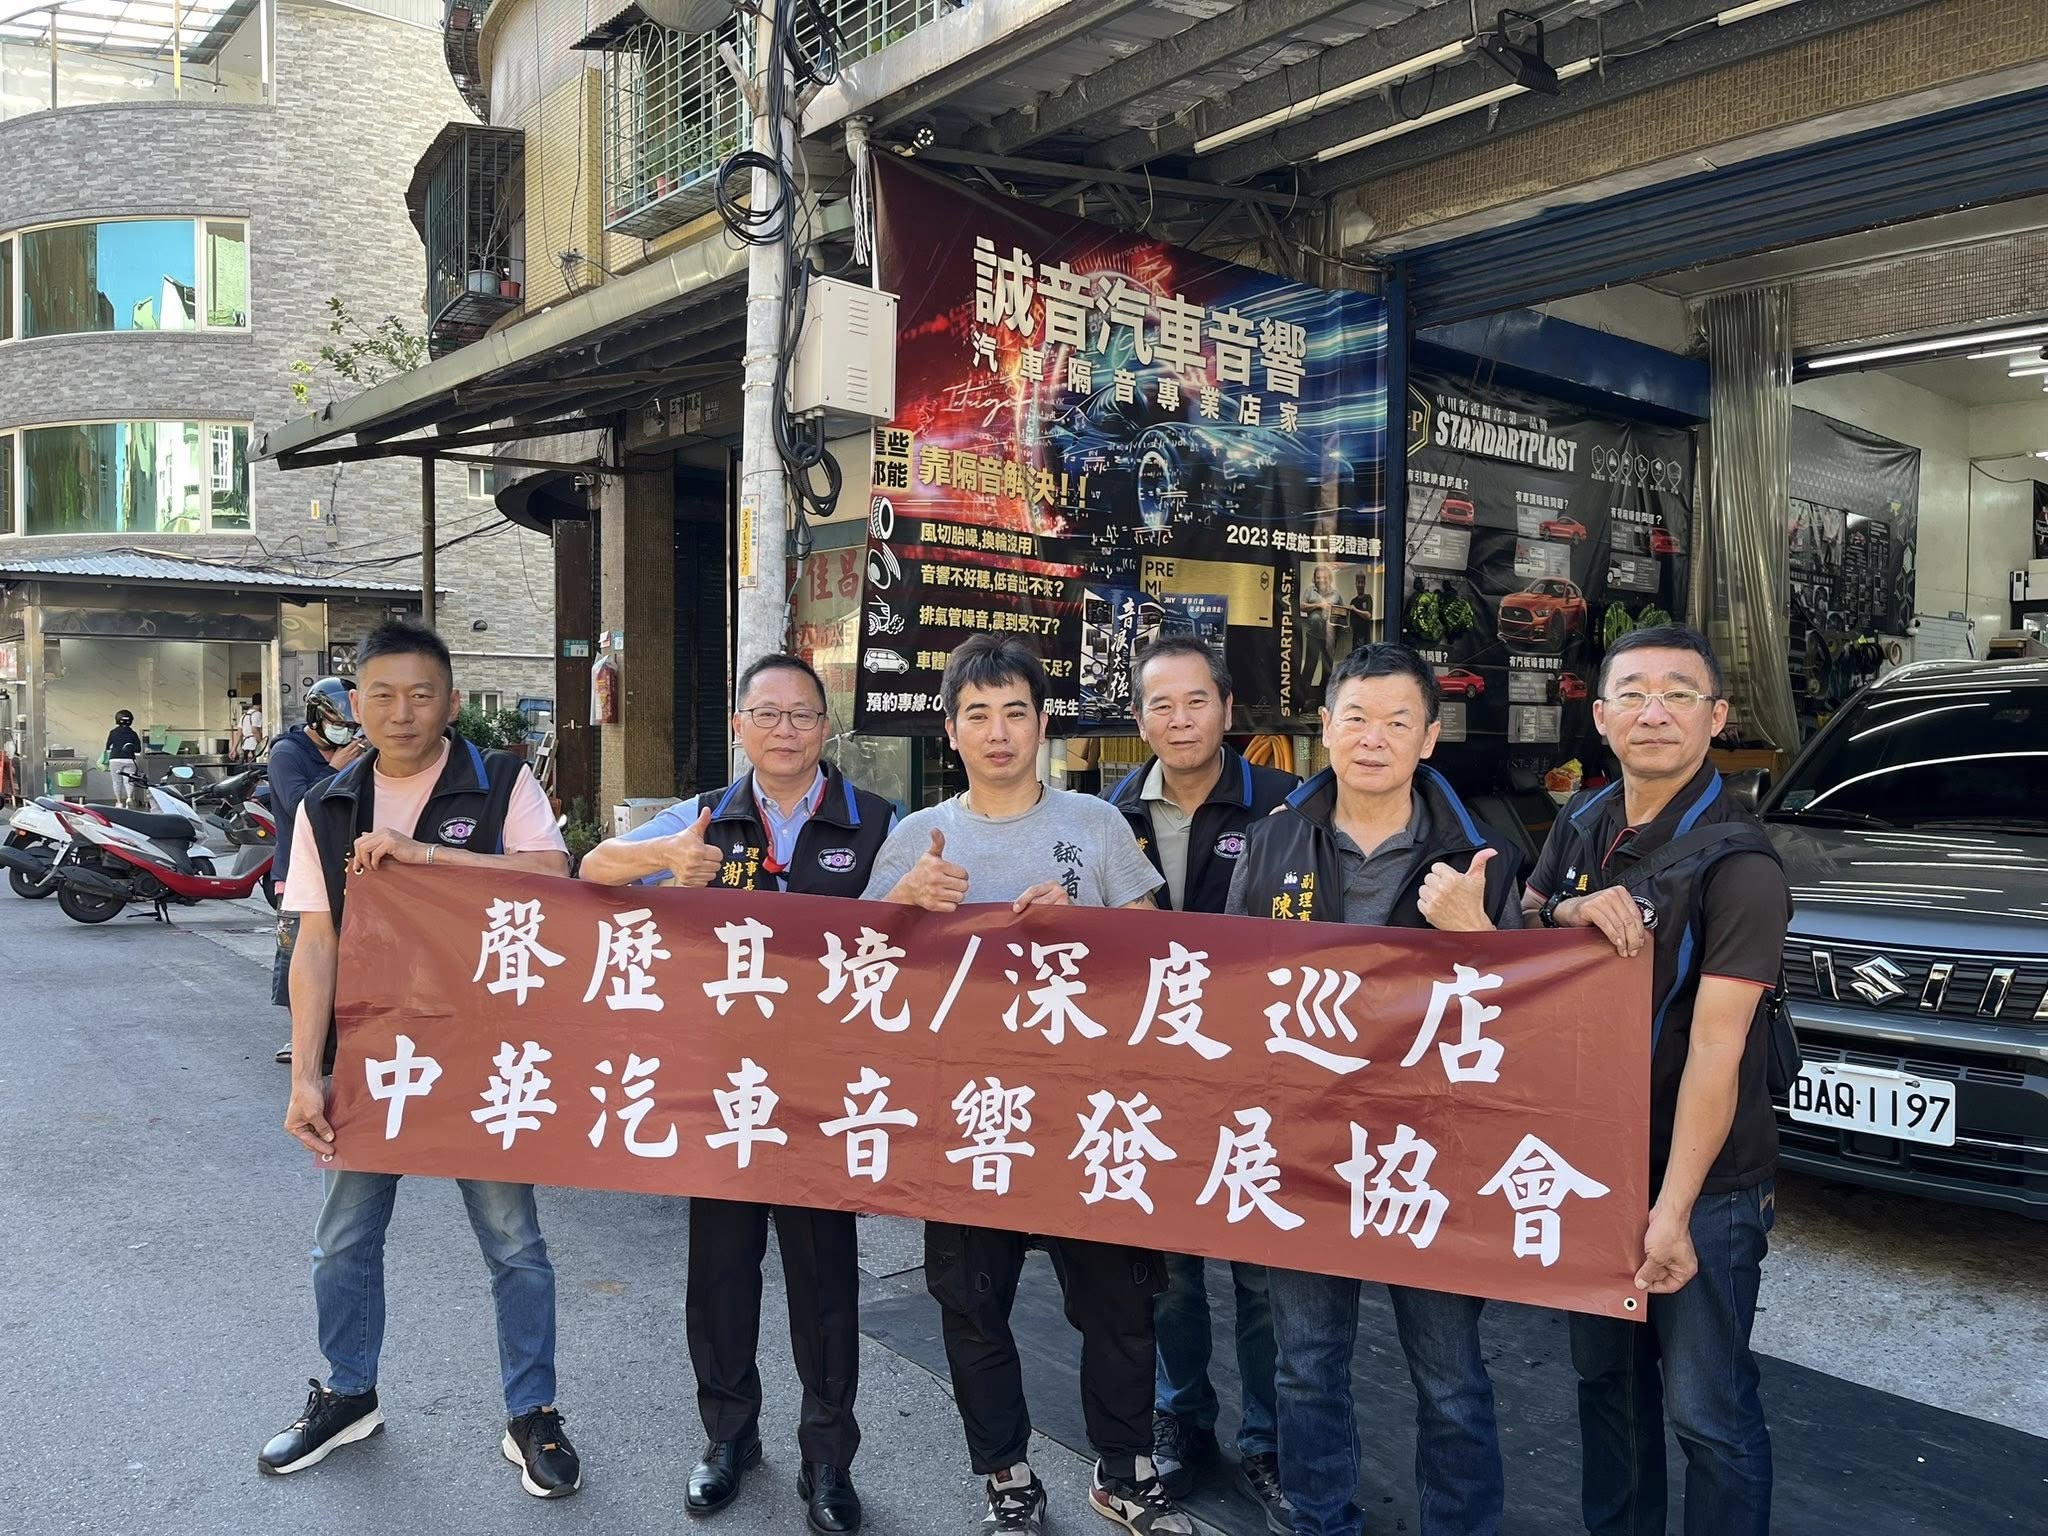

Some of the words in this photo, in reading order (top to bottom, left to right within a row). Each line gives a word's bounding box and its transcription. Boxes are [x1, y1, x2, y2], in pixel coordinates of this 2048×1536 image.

[973, 235, 1307, 398] 誠音汽車音響
[972, 329, 1299, 433] 汽車隔音專業店家
[1435, 411, 1577, 472] STANDARTPLAST
[1226, 524, 1269, 547] 2023
[1271, 529, 1382, 557] 年度施工認證證書
[1145, 561, 1174, 577] PRE
[916, 651, 952, 671] 車體
[866, 692, 944, 712] 預約專線:0
[742, 847, 760, 891] 理事長
[1052, 840, 1083, 899] 誠音
[1272, 892, 1294, 919] 陳
[473, 897, 1504, 1085] 聲歷其境/深度巡店
[364, 1035, 1610, 1267] 中華汽車音響發展協會
